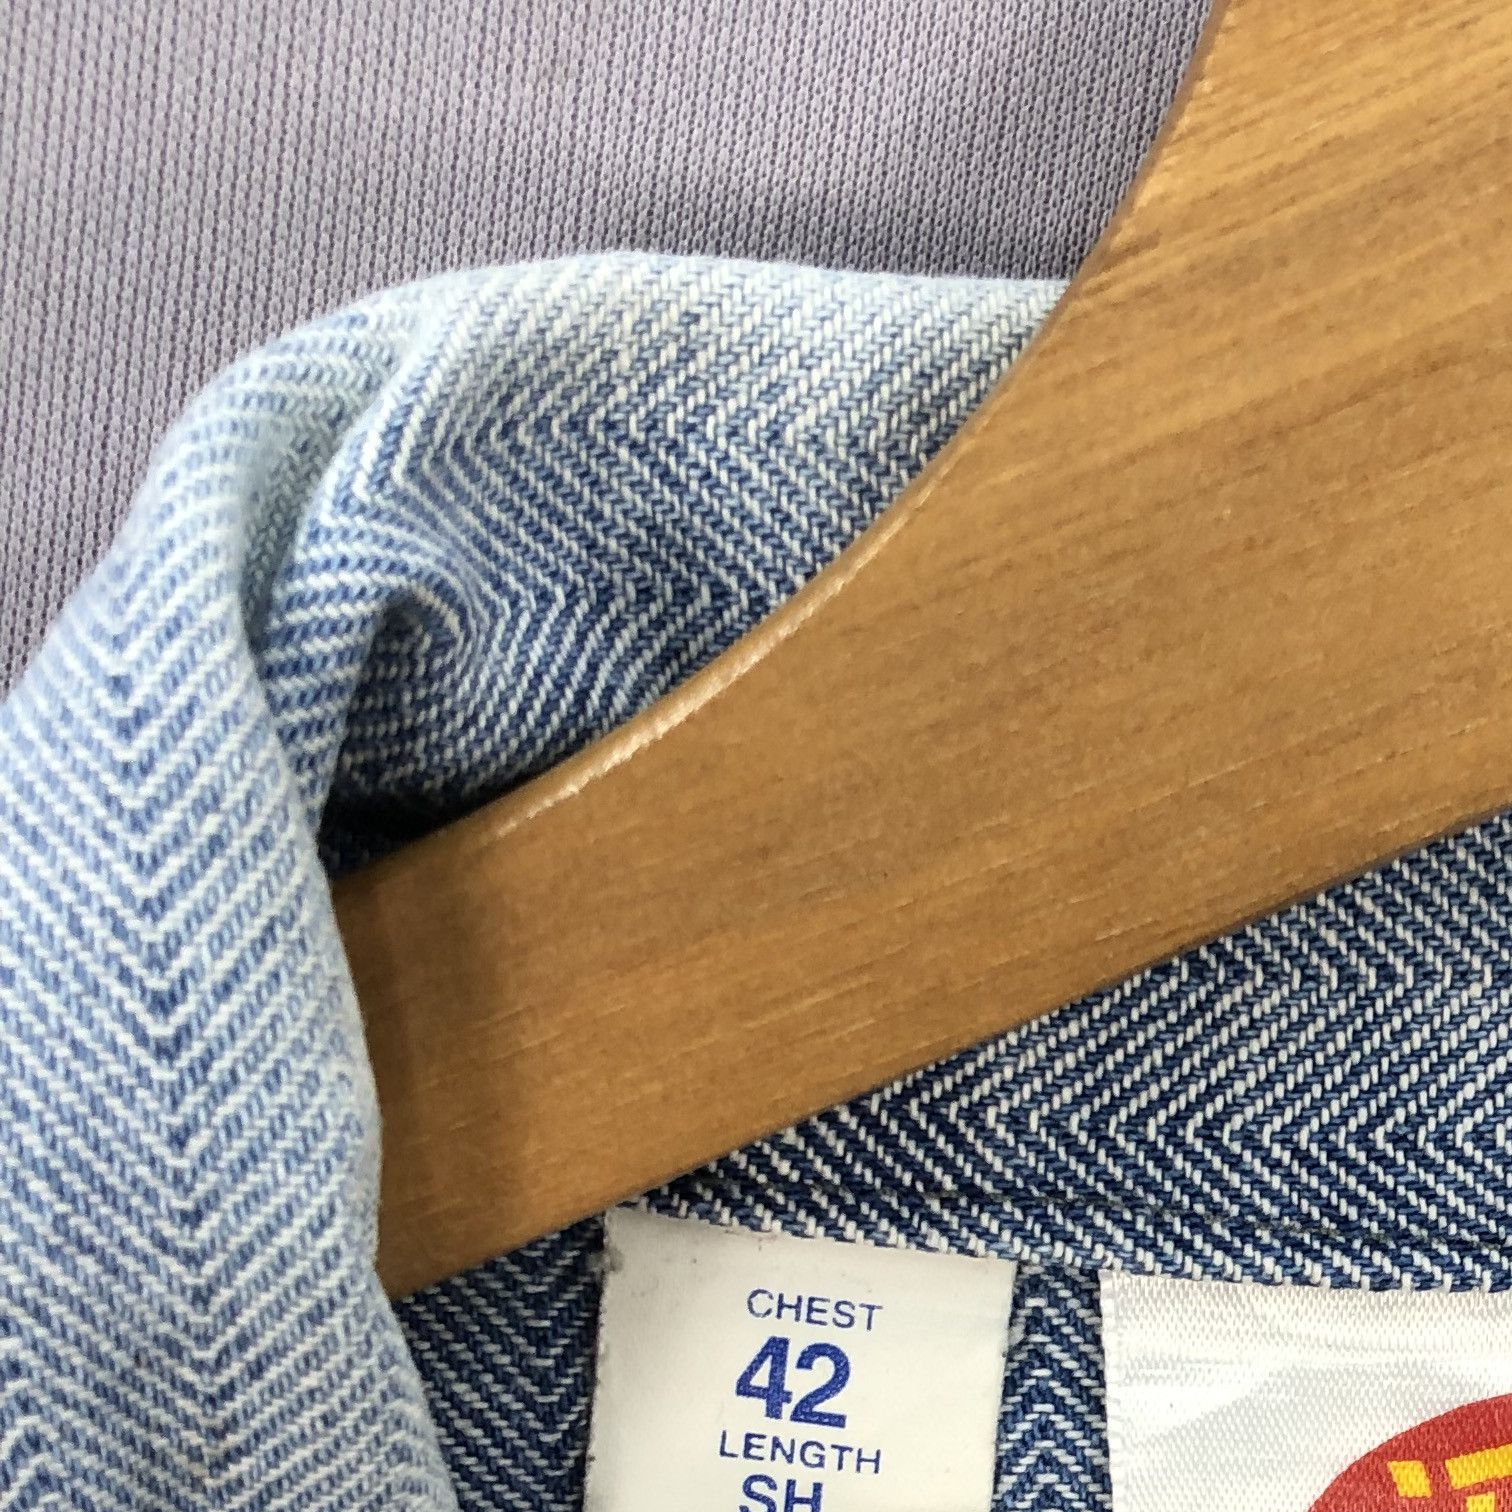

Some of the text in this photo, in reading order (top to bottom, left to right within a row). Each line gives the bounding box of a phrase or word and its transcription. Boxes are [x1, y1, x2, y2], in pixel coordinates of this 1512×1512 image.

[747, 1288, 884, 1331] CHEST
[735, 1335, 852, 1429] 42
[719, 1429, 882, 1474] LENGTH
